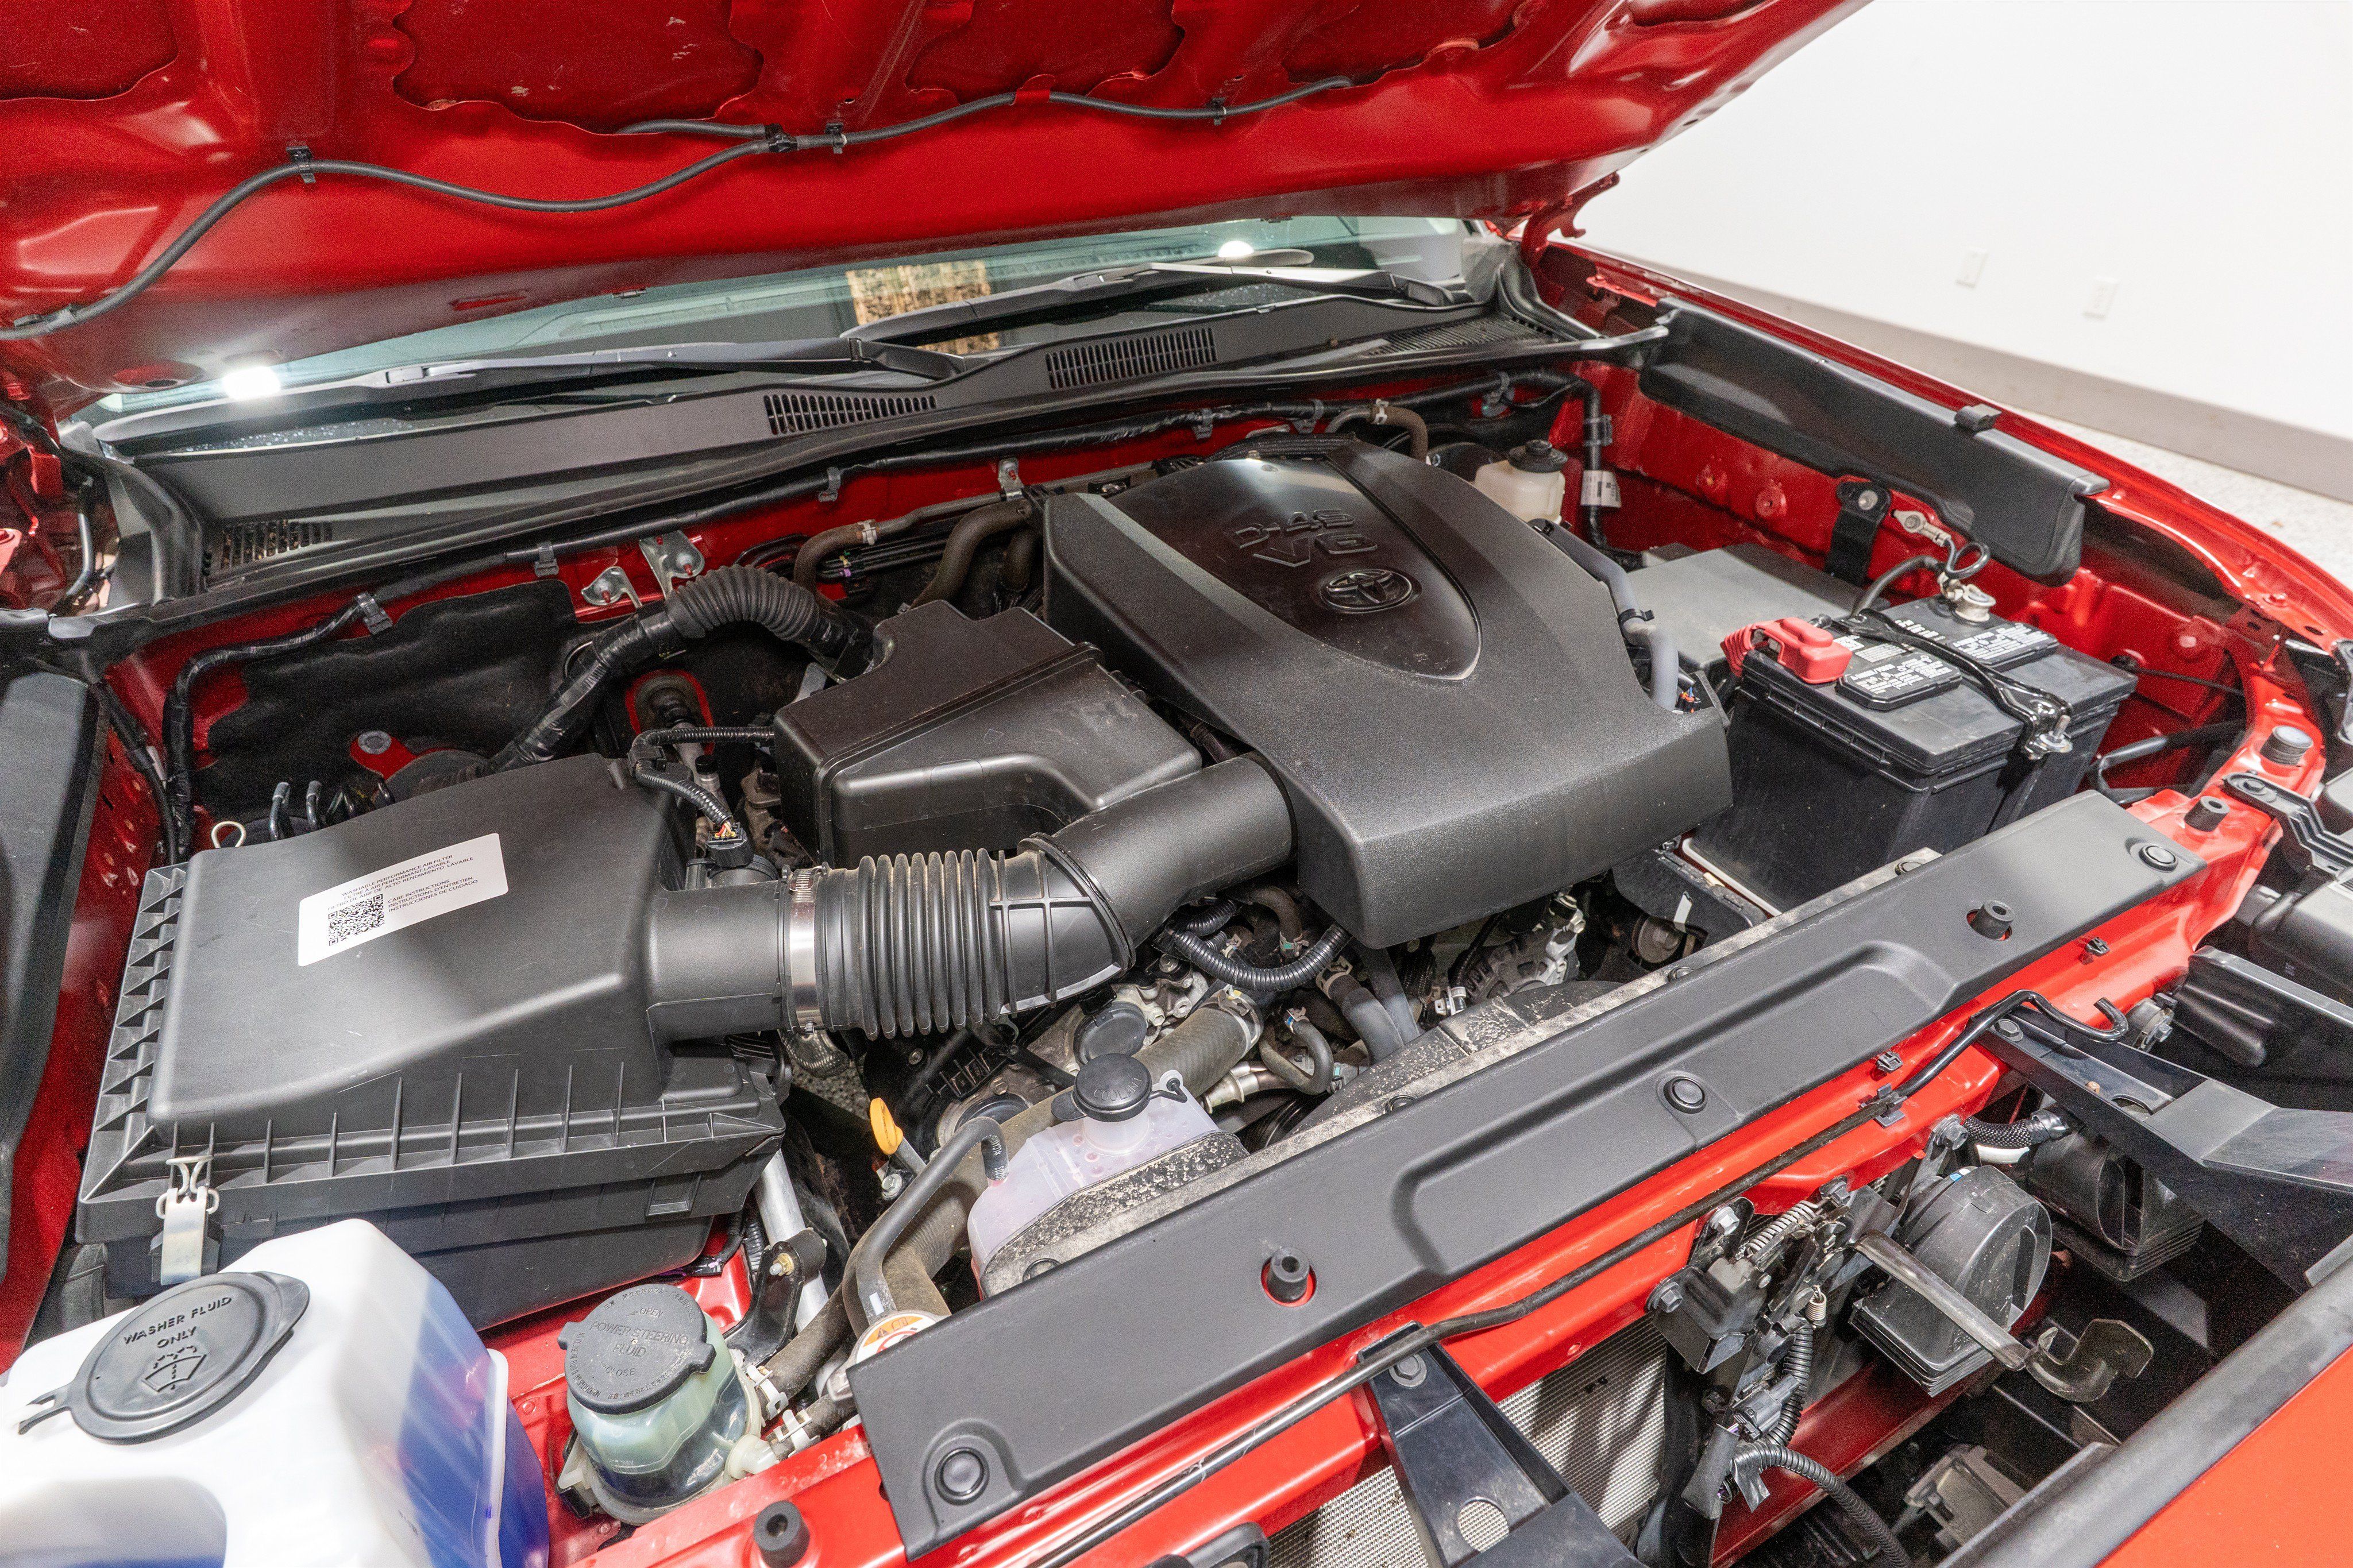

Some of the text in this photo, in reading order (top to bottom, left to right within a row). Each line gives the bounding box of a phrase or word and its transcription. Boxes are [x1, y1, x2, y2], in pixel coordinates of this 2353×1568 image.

[1253, 531, 1378, 567] V6
[327, 901, 349, 910] FILTRO
[384, 880, 401, 889] ALTO
[403, 866, 445, 882] RENDIMIENTO
[447, 856, 473, 868] LAVABLE
[342, 881, 376, 896] WASHABLE
[376, 865, 421, 885] PERFORMANCE
[434, 855, 453, 863] FILTER
[344, 890, 364, 899] FILTRE
[381, 868, 422, 886] PERFORMANT
[424, 860, 450, 871] LAVABLE
[388, 879, 450, 903] CARE INSTRUCTIONS
[388, 876, 473, 907] INSTRUCTIONS D'ENTRETIEN
[388, 893, 438, 912] INSTRUCCIONES
[449, 879, 478, 891] CUIDADO
[124, 1296, 232, 1345] WASHER FLUID
[639, 1307, 664, 1318] OPEN
[157, 1326, 197, 1348] ONLY
[589, 1321, 689, 1345] POWER STEERING
[612, 1344, 647, 1357] FLUID
[605, 1366, 635, 1377] CLOSE
